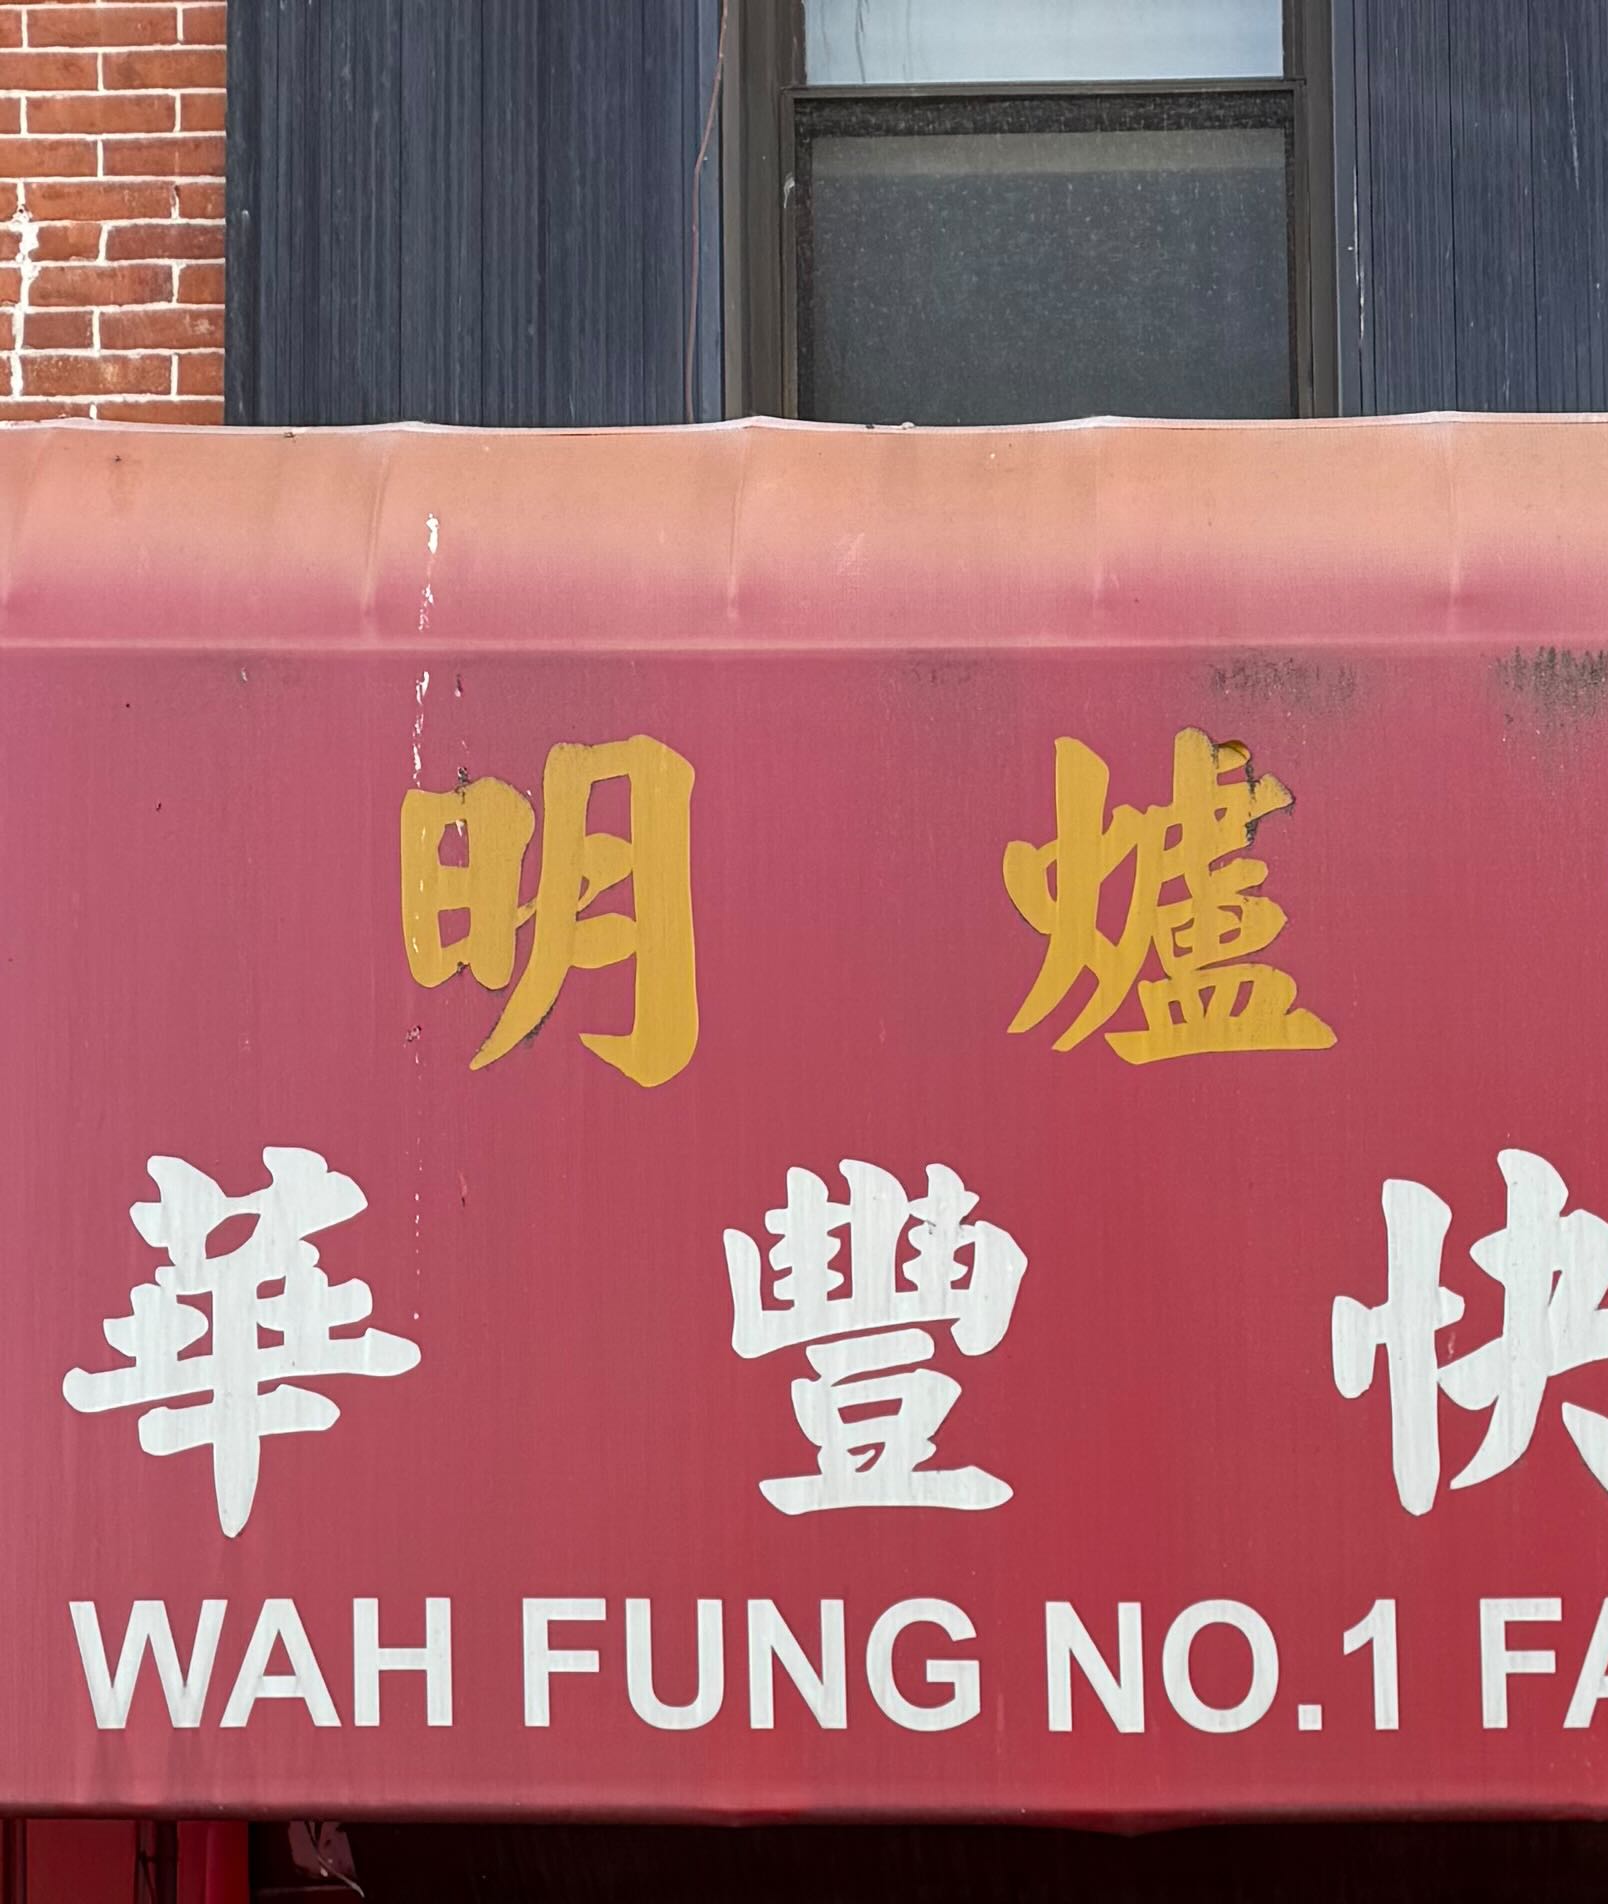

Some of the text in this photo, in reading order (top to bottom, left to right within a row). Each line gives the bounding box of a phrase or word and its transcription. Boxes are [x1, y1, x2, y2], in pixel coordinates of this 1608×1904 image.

[68, 1597, 454, 1729] WAH
[522, 1598, 982, 1732] FUNG
[1045, 1599, 1400, 1733] NO.1
